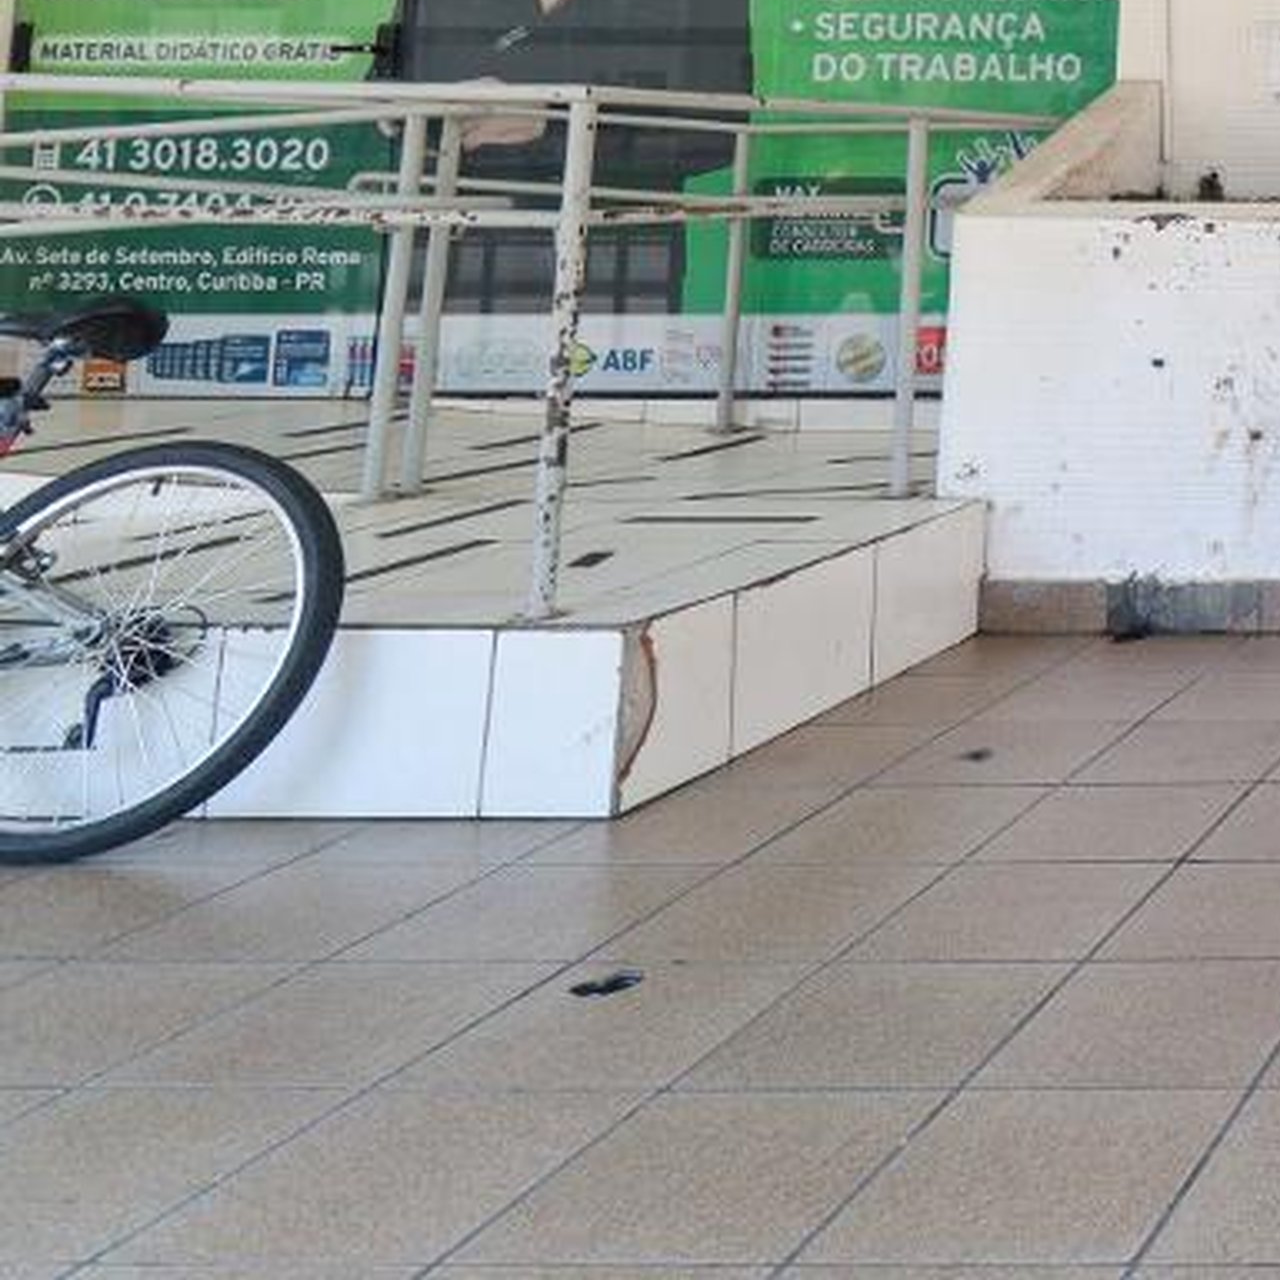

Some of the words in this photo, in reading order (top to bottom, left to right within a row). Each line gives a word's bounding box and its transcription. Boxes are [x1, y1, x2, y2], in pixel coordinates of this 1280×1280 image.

[814, 13, 1045, 51] SEGURANÇA
[41, 41, 149, 61] MATERIAL
[155, 37, 258, 61] DIDÁTICO
[812, 53, 866, 82] DO
[878, 53, 1082, 82] TRABALHO
[76, 138, 117, 170] 41
[129, 137, 329, 171] 3018.3020
[0, 247, 31, 265] Av.
[36, 246, 81, 265] Sete
[86, 247, 111, 265] de
[115, 246, 218, 267] Setembro,
[57, 271, 115, 292] 3293,
[119, 272, 192, 293] Centro,
[295, 272, 326, 291] PR
[603, 348, 654, 371] ABF
